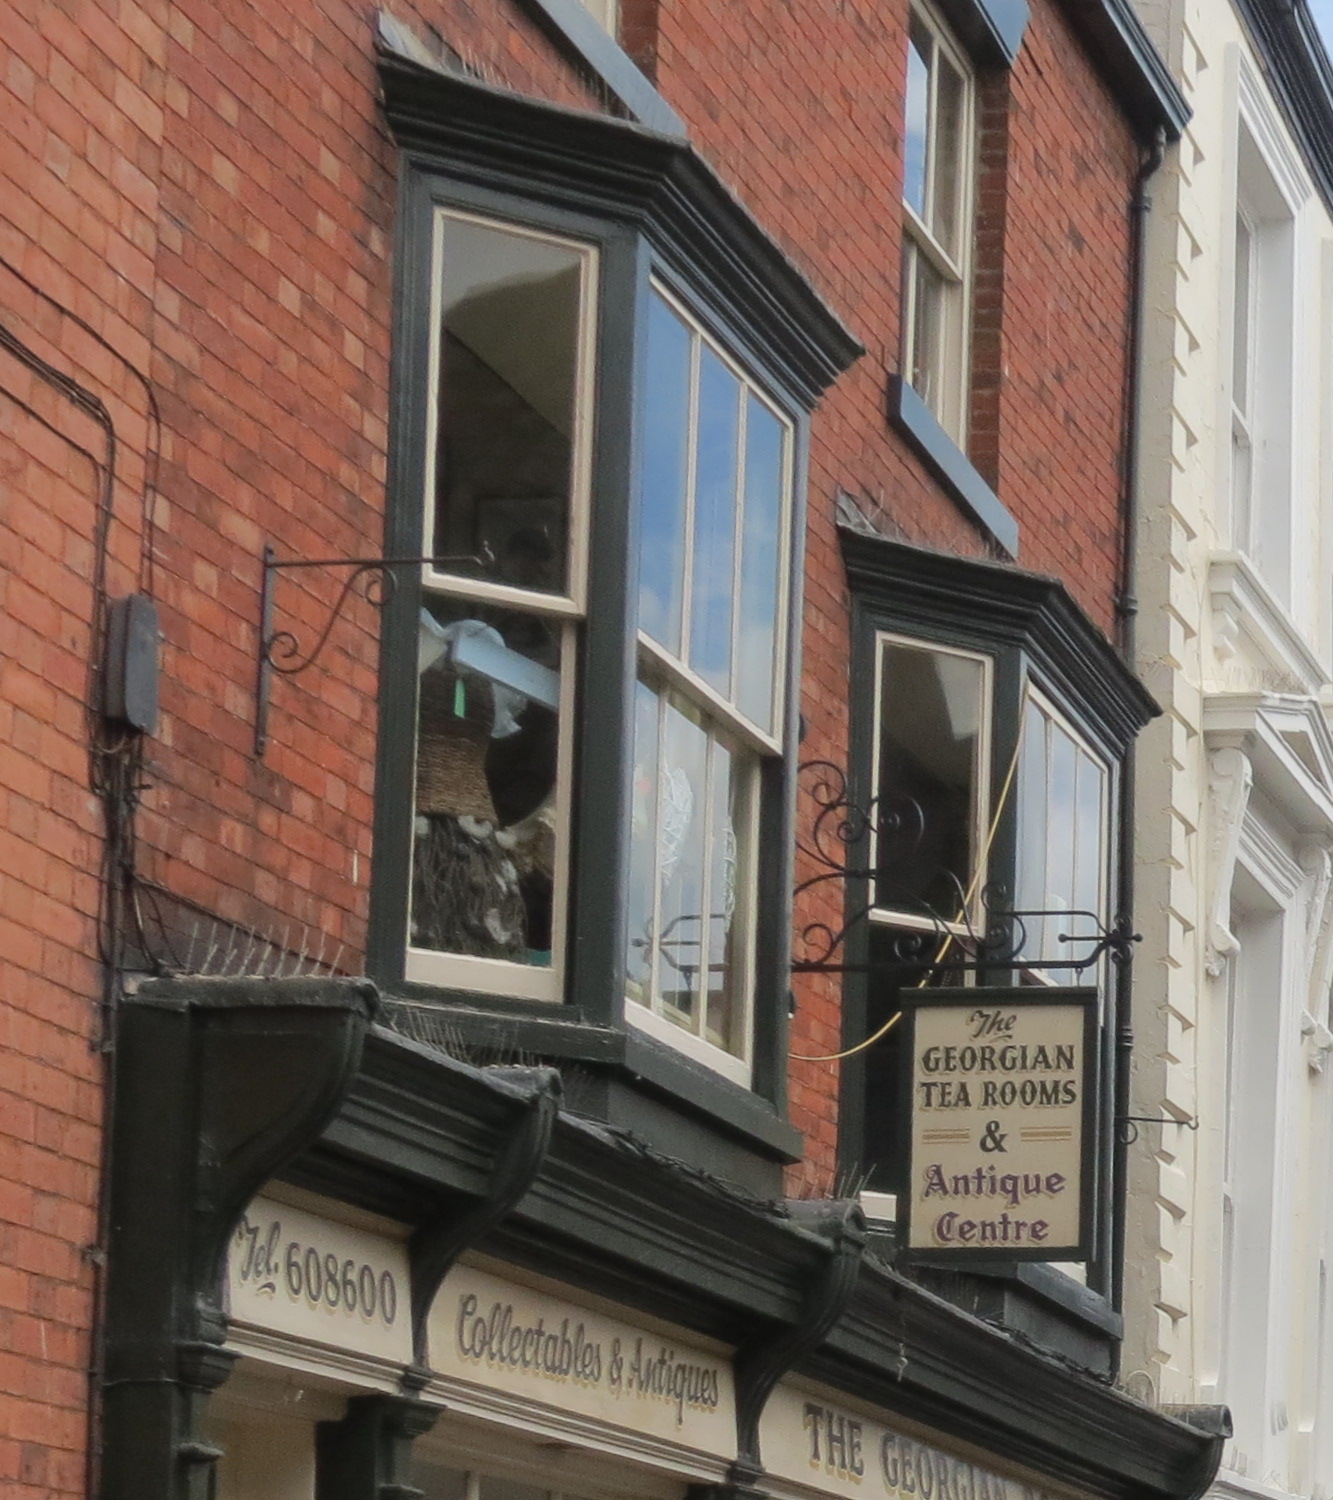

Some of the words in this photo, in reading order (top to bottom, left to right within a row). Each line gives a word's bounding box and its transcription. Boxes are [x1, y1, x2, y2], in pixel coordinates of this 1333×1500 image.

[967, 1009, 1017, 1039] The
[921, 1043, 1076, 1076] GEORGIAN
[919, 1080, 972, 1110] TEA
[978, 1079, 1078, 1110] ROOMS
[978, 1119, 1009, 1153] &
[922, 1163, 1067, 1208] Antique
[935, 1209, 1050, 1245] Centre
[235, 1219, 278, 1282] Tel.
[286, 1240, 397, 1325] 608600
[456, 1293, 602, 1384] Collectables
[606, 1336, 626, 1397] &
[629, 1336, 720, 1429] Antiques
[803, 1402, 866, 1485] THE
